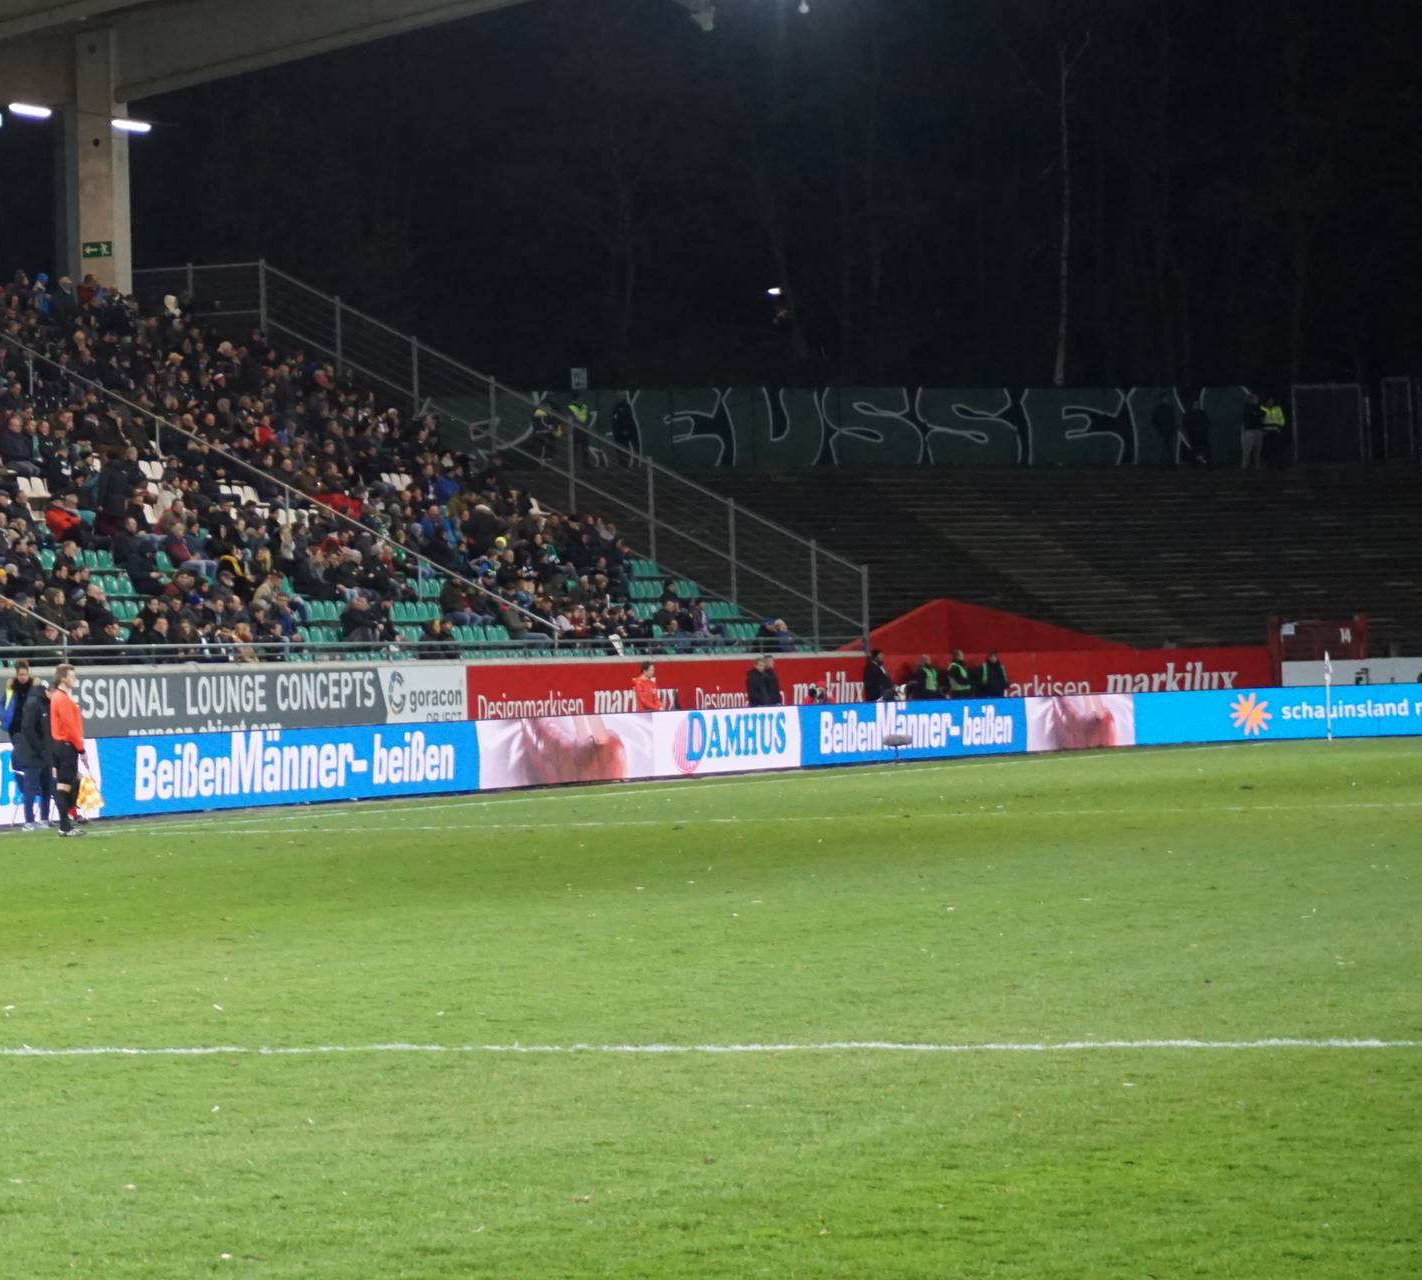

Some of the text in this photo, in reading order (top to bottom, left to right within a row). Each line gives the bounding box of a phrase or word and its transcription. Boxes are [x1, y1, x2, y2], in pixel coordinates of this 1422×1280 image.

[1339, 627, 1352, 644] 14
[186, 674, 267, 716] LOUNGE
[277, 671, 376, 712] CONCEPTS
[1106, 661, 1238, 694] markilux
[409, 689, 462, 713] goracon
[1281, 697, 1409, 720] schauinsland
[687, 711, 787, 762] DAMHUS
[963, 704, 1013, 747] beißen
[373, 731, 455, 786] beißen
